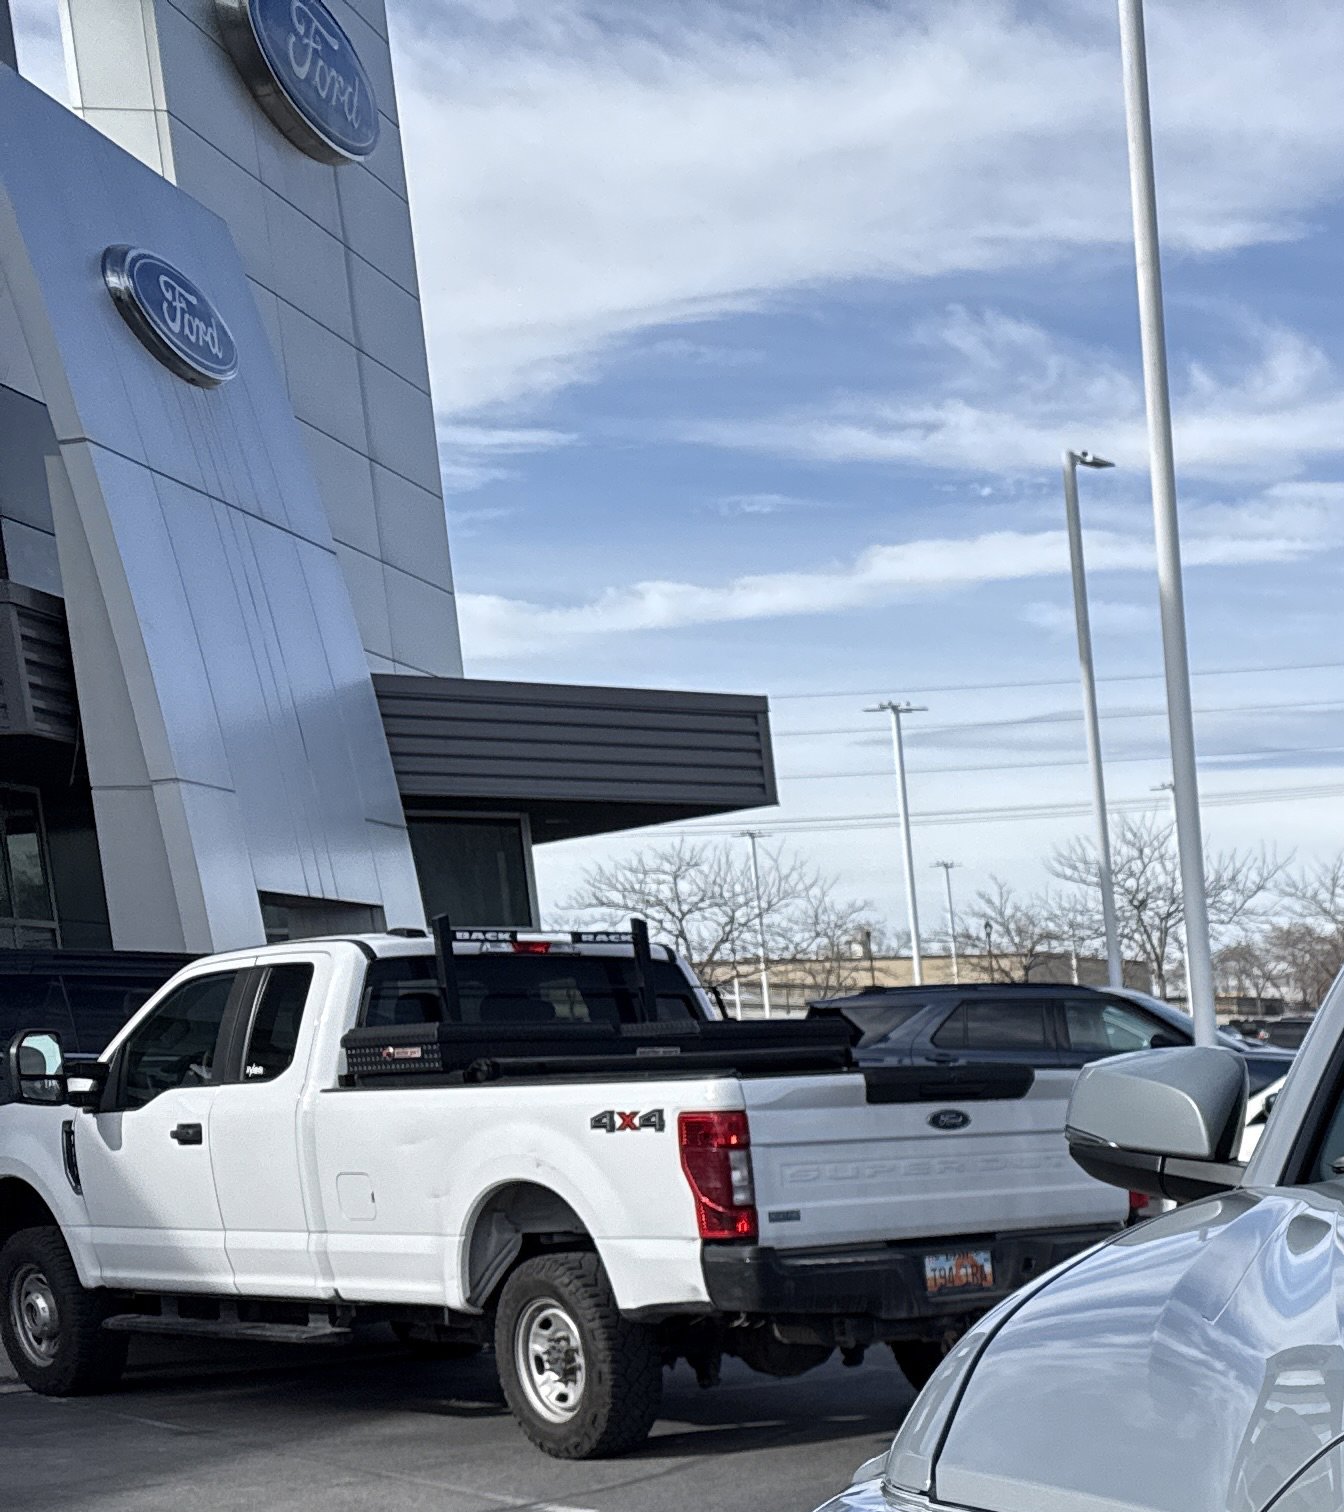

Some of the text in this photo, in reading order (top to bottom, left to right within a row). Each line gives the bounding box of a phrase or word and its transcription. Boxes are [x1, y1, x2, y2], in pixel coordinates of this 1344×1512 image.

[286, 1, 361, 129] Ford
[159, 274, 222, 359] Ford
[455, 931, 634, 942] BACK RACK
